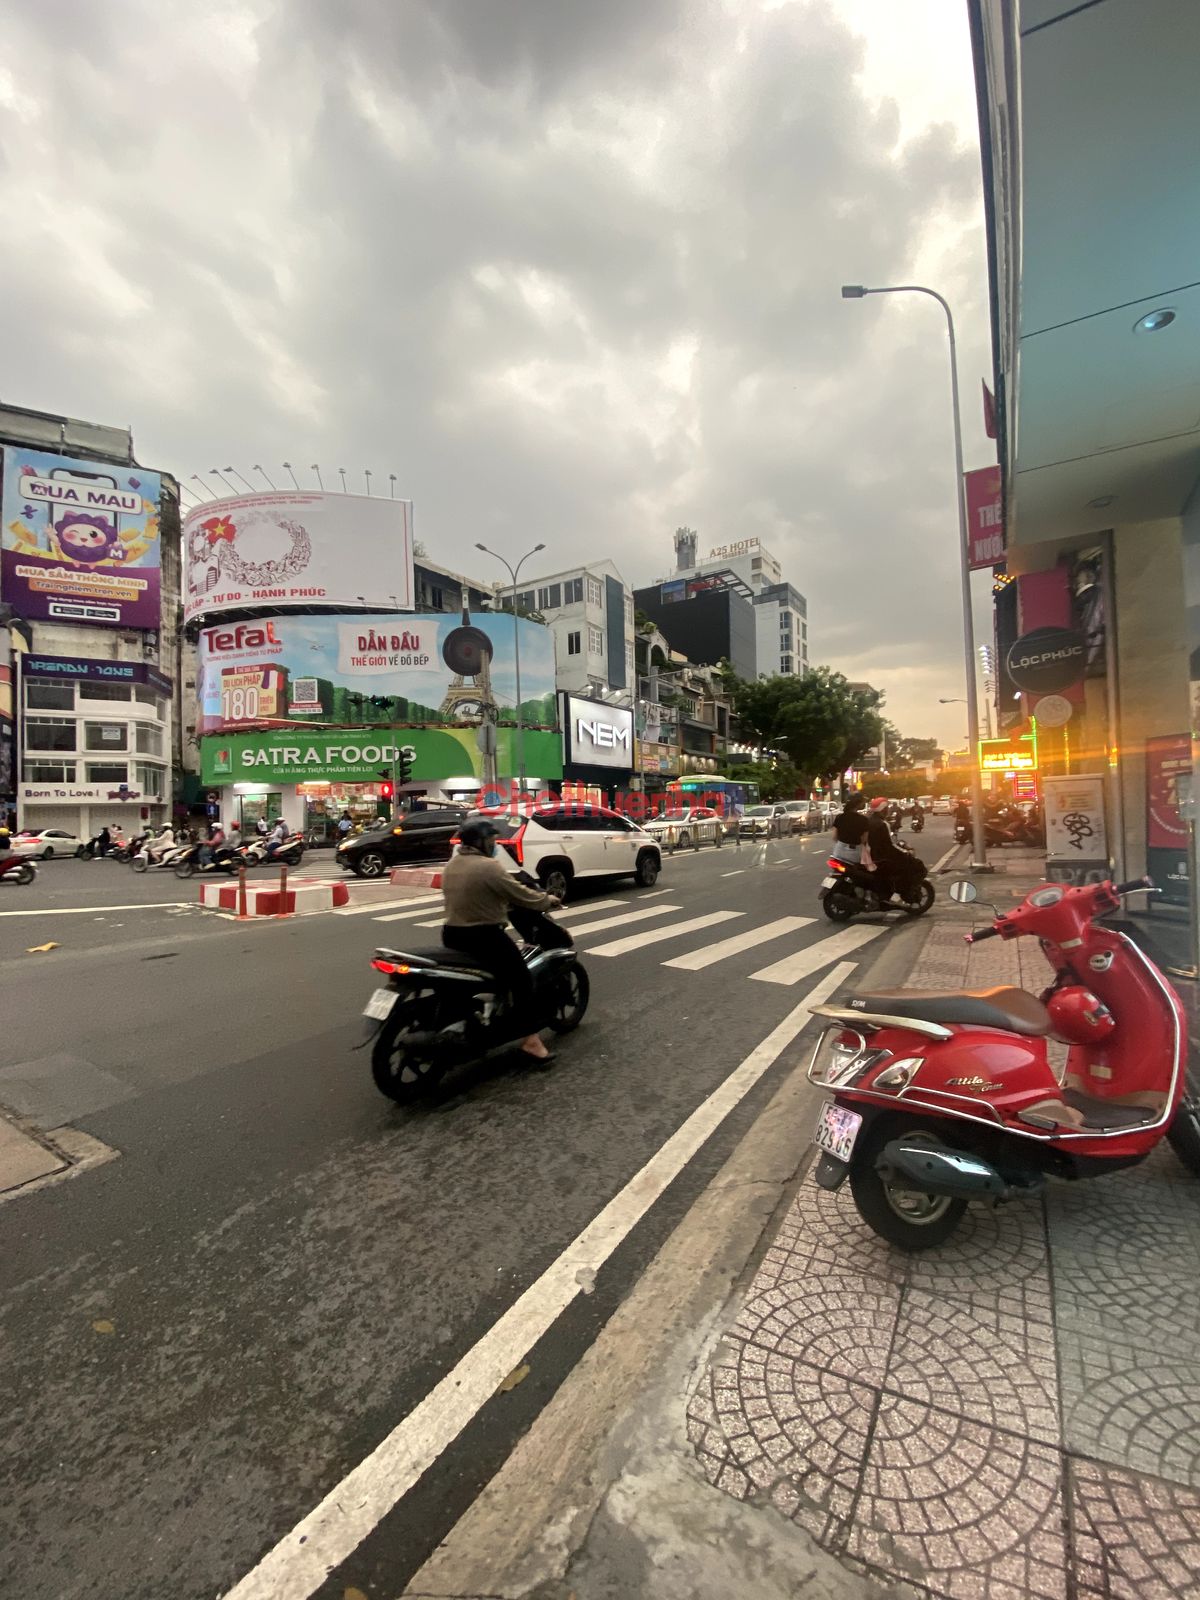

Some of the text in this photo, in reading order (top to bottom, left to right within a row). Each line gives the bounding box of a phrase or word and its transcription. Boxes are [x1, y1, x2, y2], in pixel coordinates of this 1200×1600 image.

[30, 482, 136, 509] MUA MAU
[730, 537, 760, 553] HOTEL
[18, 567, 45, 576] MUA
[76, 572, 115, 585] THÔNG
[117, 579, 147, 588] MINH
[227, 592, 241, 601] DO
[253, 589, 286, 600] HẠNH
[290, 587, 326, 597] PHÚC
[203, 621, 282, 653] Tefal
[358, 630, 420, 651] DẪN ĐẦU
[351, 654, 367, 666] THẾ
[369, 654, 387, 666] GIỚI
[388, 653, 399, 666] VỀ
[414, 653, 429, 665] BẾP
[1010, 653, 1041, 669] LỘC
[222, 687, 258, 721] 180
[577, 719, 629, 749] NEM
[241, 745, 417, 767] SATRA FOODS
[54, 789, 66, 797] To
